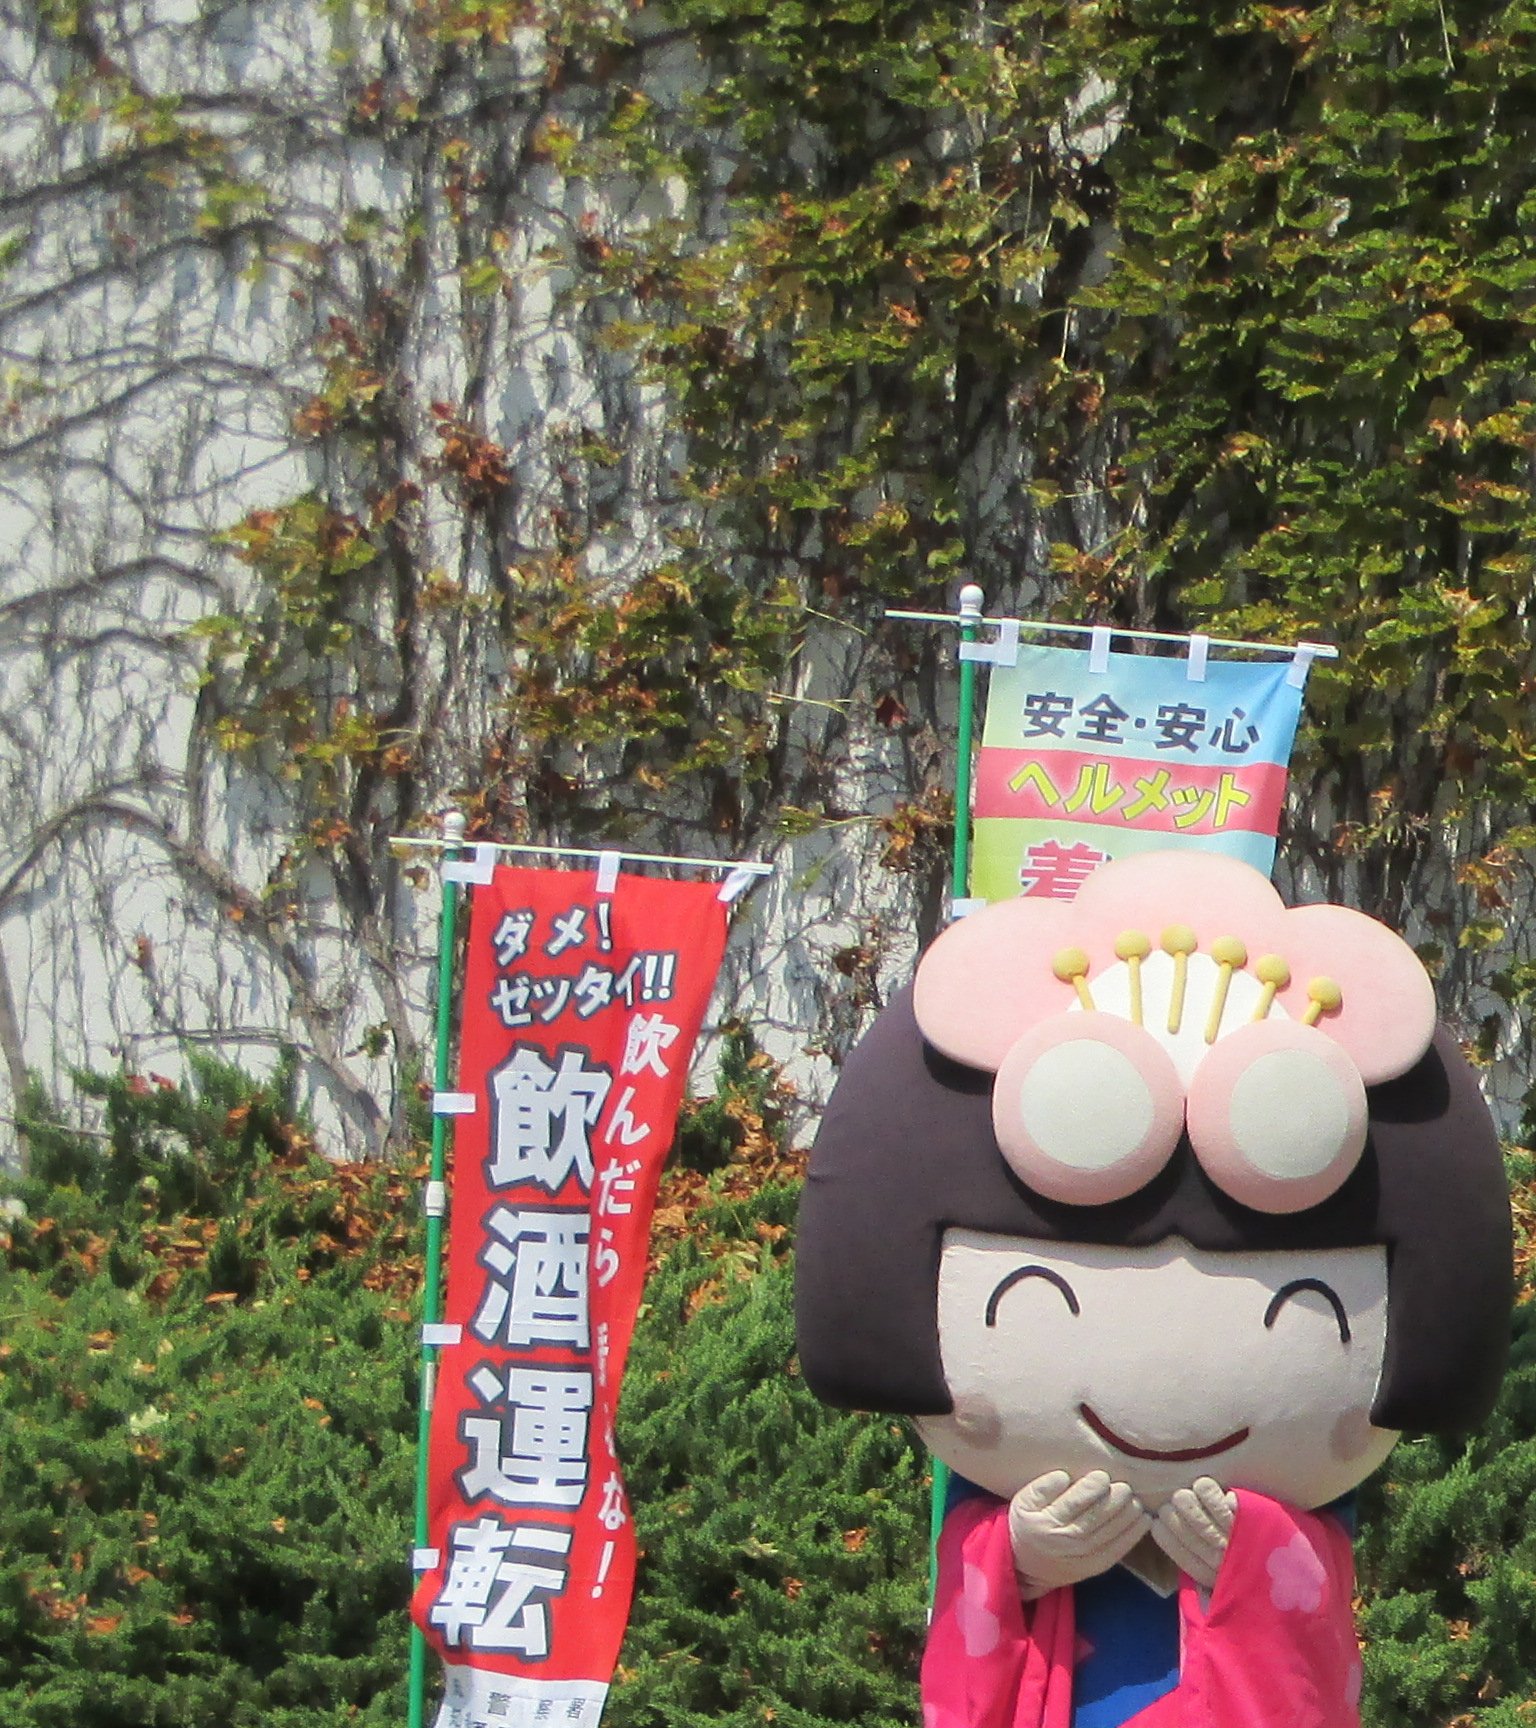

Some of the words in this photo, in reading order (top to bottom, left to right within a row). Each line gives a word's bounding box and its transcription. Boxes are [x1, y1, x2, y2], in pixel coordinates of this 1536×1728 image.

[1022, 691, 1262, 754] 安全・安心
[1008, 761, 1252, 829] ヘルメット
[493, 902, 613, 966] ダメ!
[430, 1048, 613, 1657] 飲酒運転
